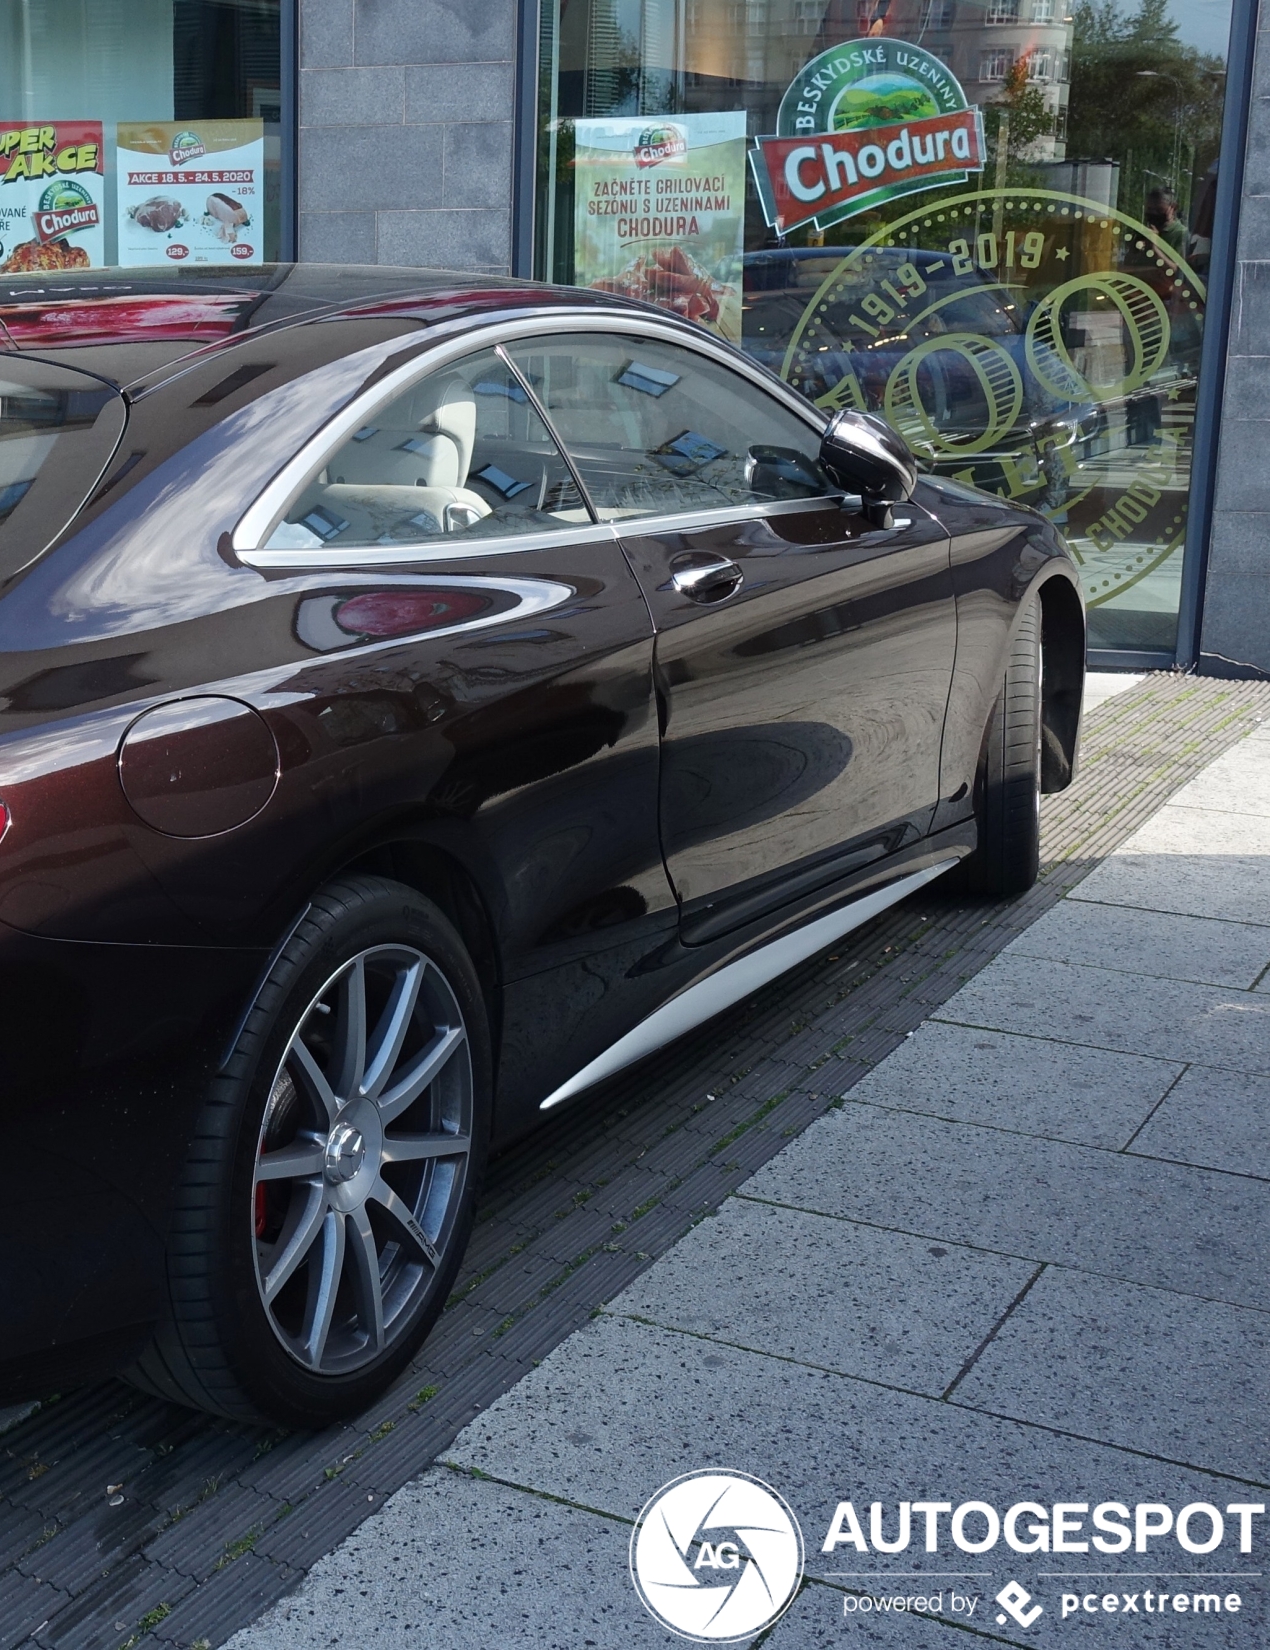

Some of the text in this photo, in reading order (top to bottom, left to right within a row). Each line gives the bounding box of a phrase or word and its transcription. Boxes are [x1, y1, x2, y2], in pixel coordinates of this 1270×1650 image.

[796, 45, 957, 129] BESKYDSKÉ UZENINY
[173, 147, 204, 162] Chodura
[639, 140, 686, 163] Chodura
[2, 143, 100, 184] AKCE
[784, 127, 971, 202] Chodura
[130, 173, 158, 183] AKCE
[223, 172, 251, 181] 2020
[594, 174, 725, 197] ZAČNĚTE GRILOVACÍ
[588, 195, 730, 216] SEZÓNU S UZENINAMI
[40, 208, 97, 235] Chodura
[617, 216, 700, 238] CHODURA
